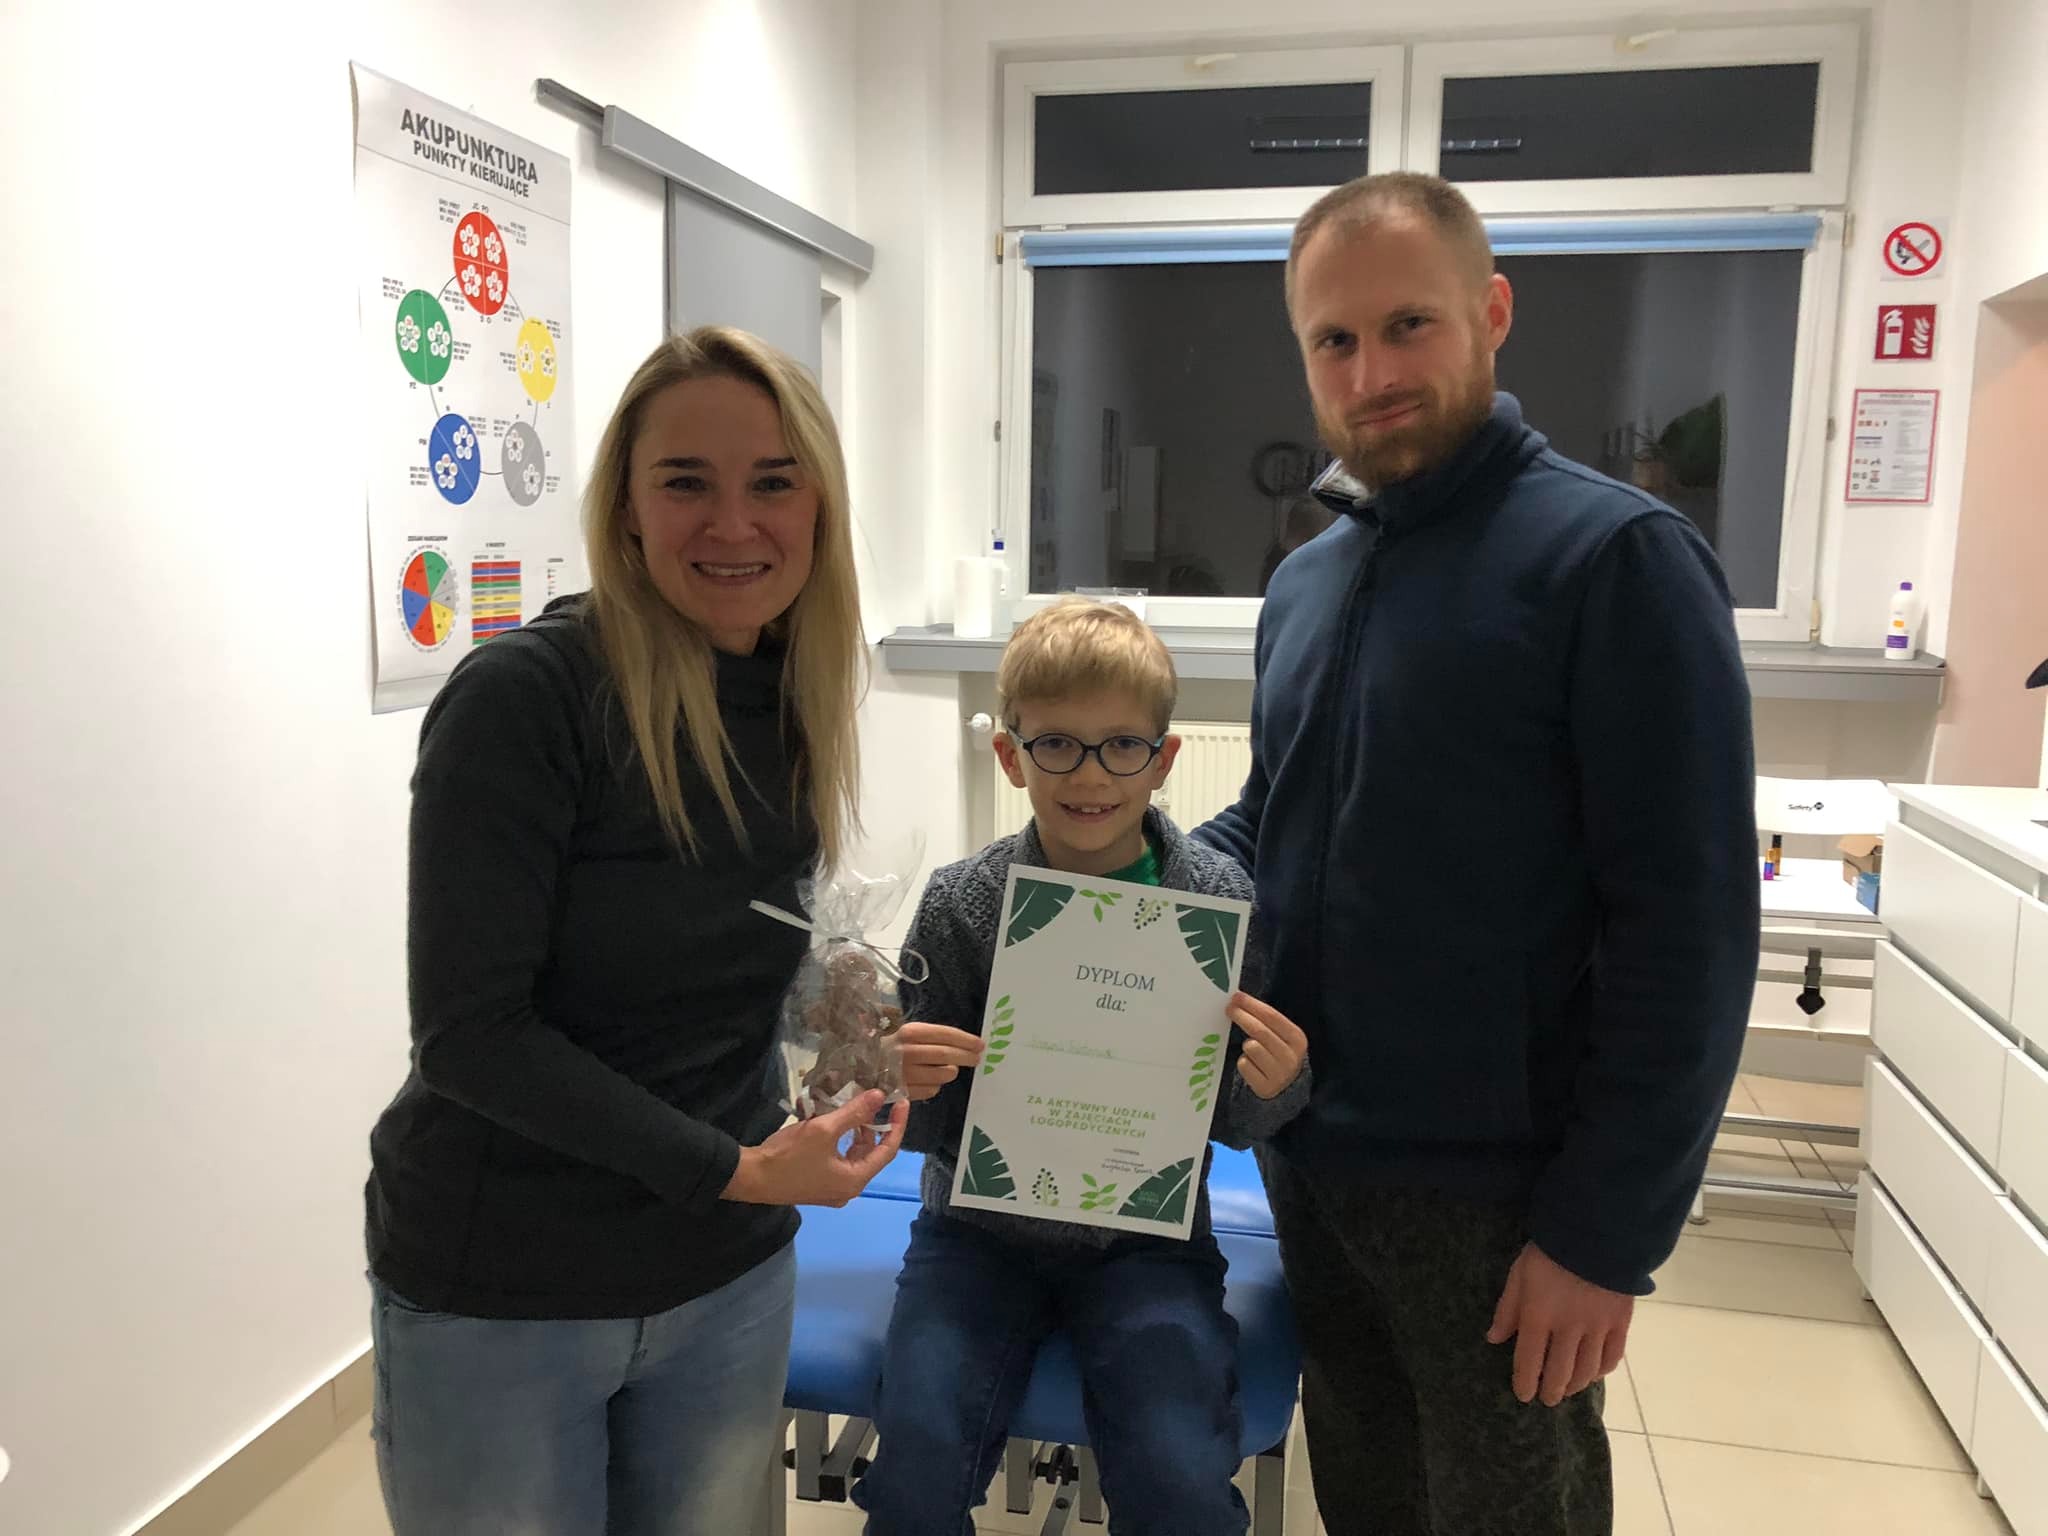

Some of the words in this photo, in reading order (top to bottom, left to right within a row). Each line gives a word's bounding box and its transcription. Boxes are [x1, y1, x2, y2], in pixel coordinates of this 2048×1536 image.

[401, 108, 538, 184] AKUPUNKTURA
[413, 140, 466, 172] PUNKTY
[470, 161, 529, 197] KIERUJĄCE
[1076, 965, 1155, 991] DYPLOM
[1096, 993, 1127, 1012] dla:
[1027, 1095, 1042, 1105] ZA
[1047, 1098, 1108, 1113] AKTYWNY
[1049, 1108, 1061, 1117] W
[1030, 1115, 1146, 1139] LOGOPEDYCZNYCH
